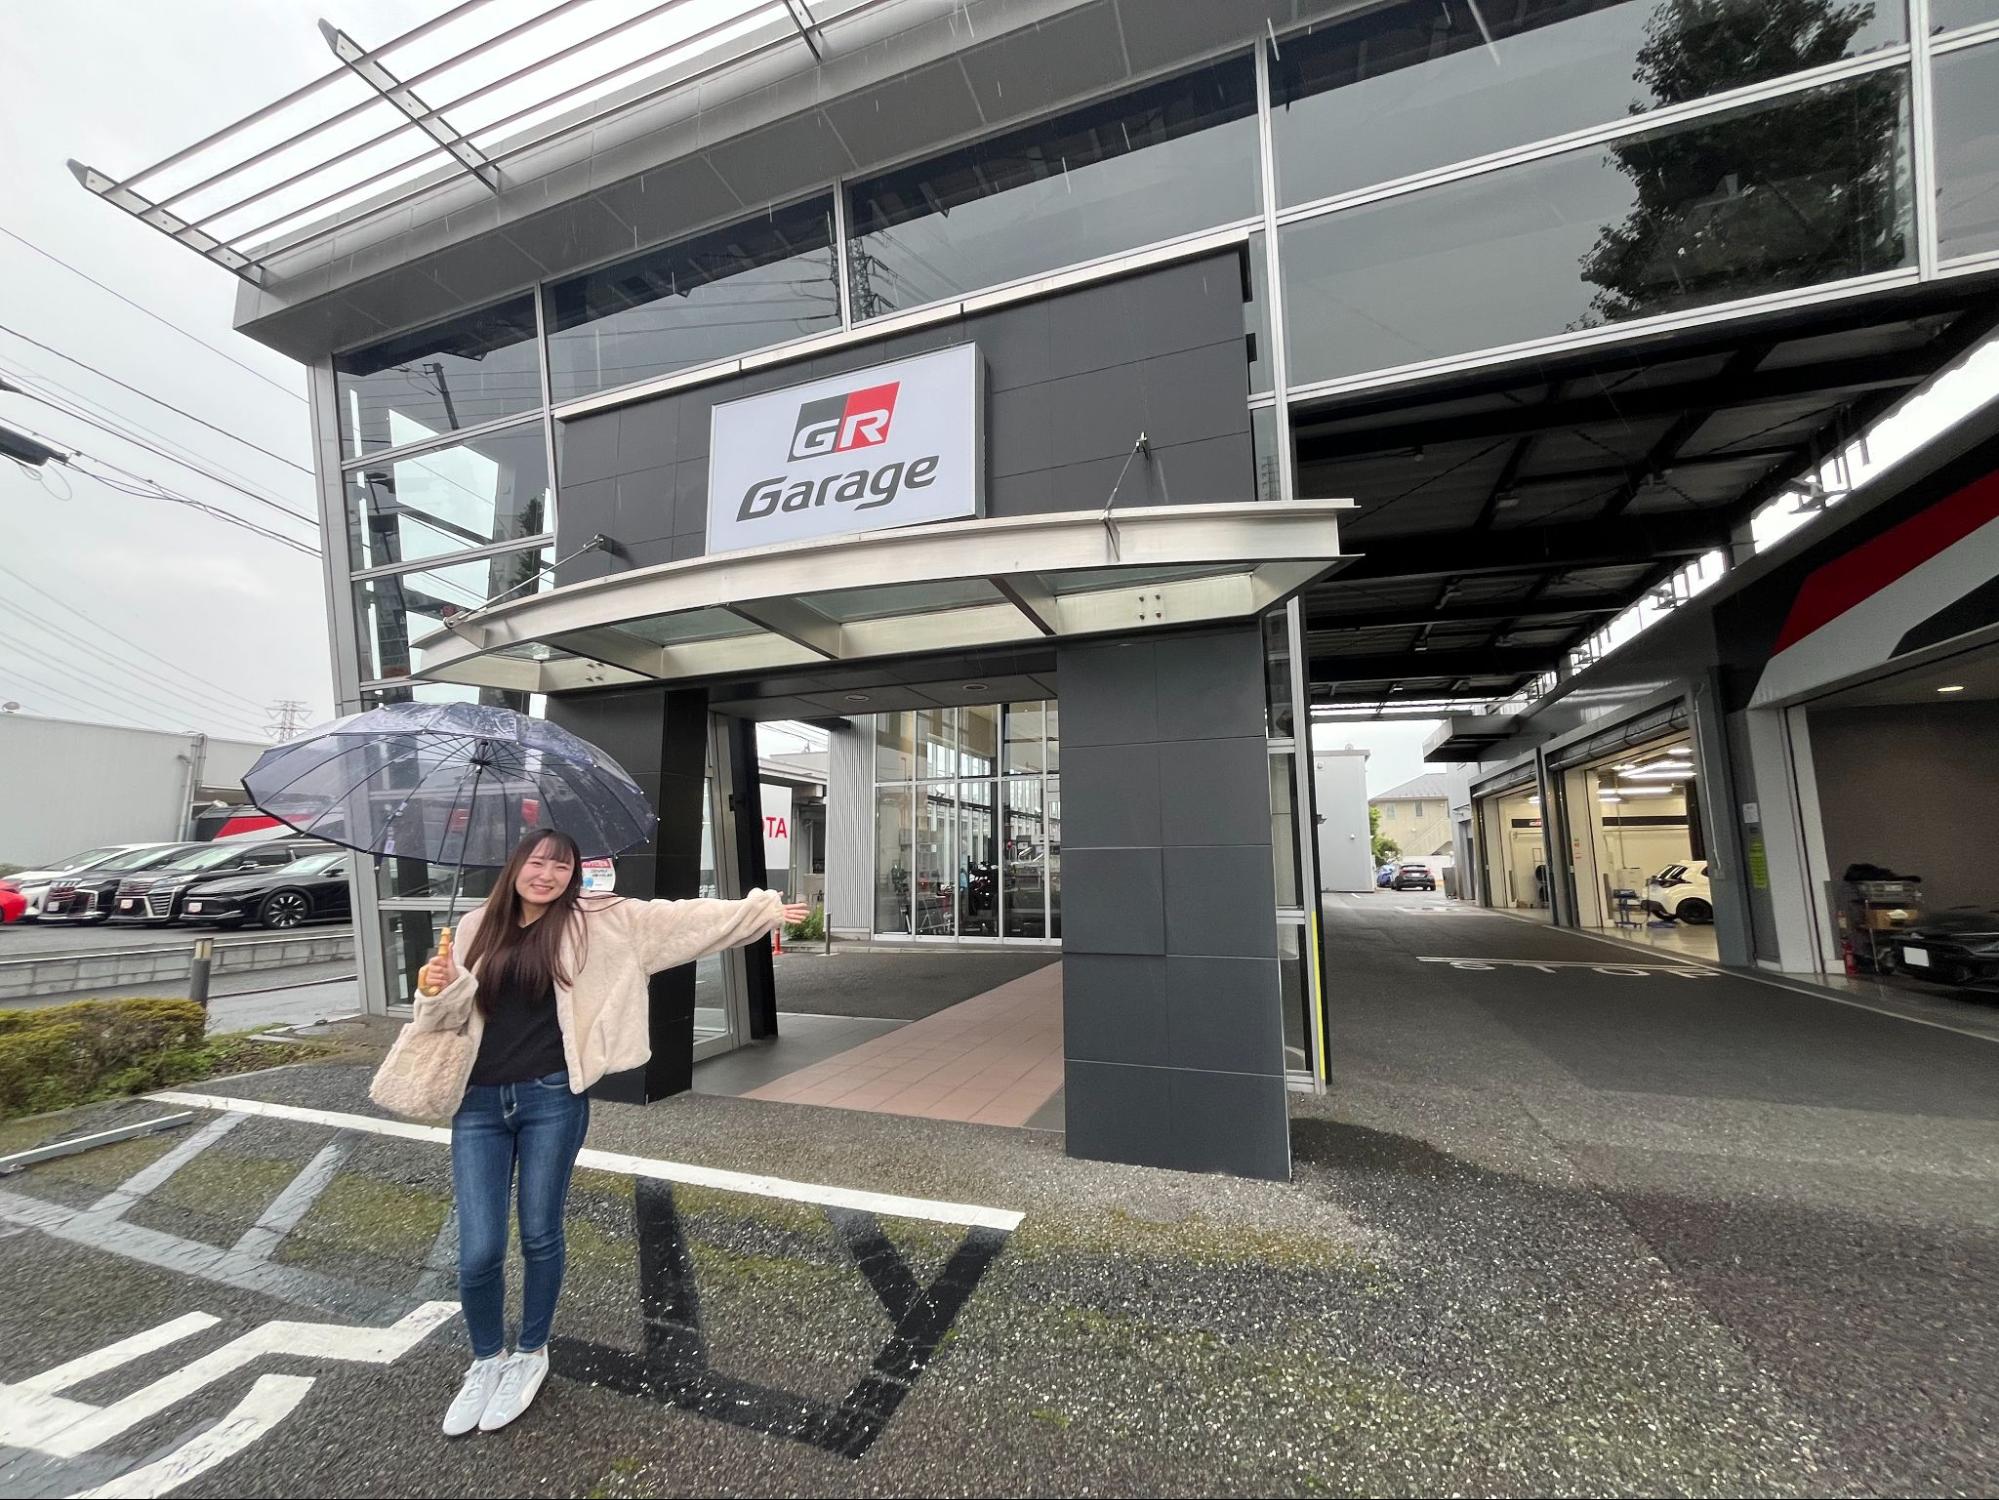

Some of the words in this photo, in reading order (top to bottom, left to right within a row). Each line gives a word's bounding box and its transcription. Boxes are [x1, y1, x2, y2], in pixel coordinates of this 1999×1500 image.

[791, 408, 890, 458] GR
[736, 455, 940, 522] Garage
[762, 816, 787, 838] TA
